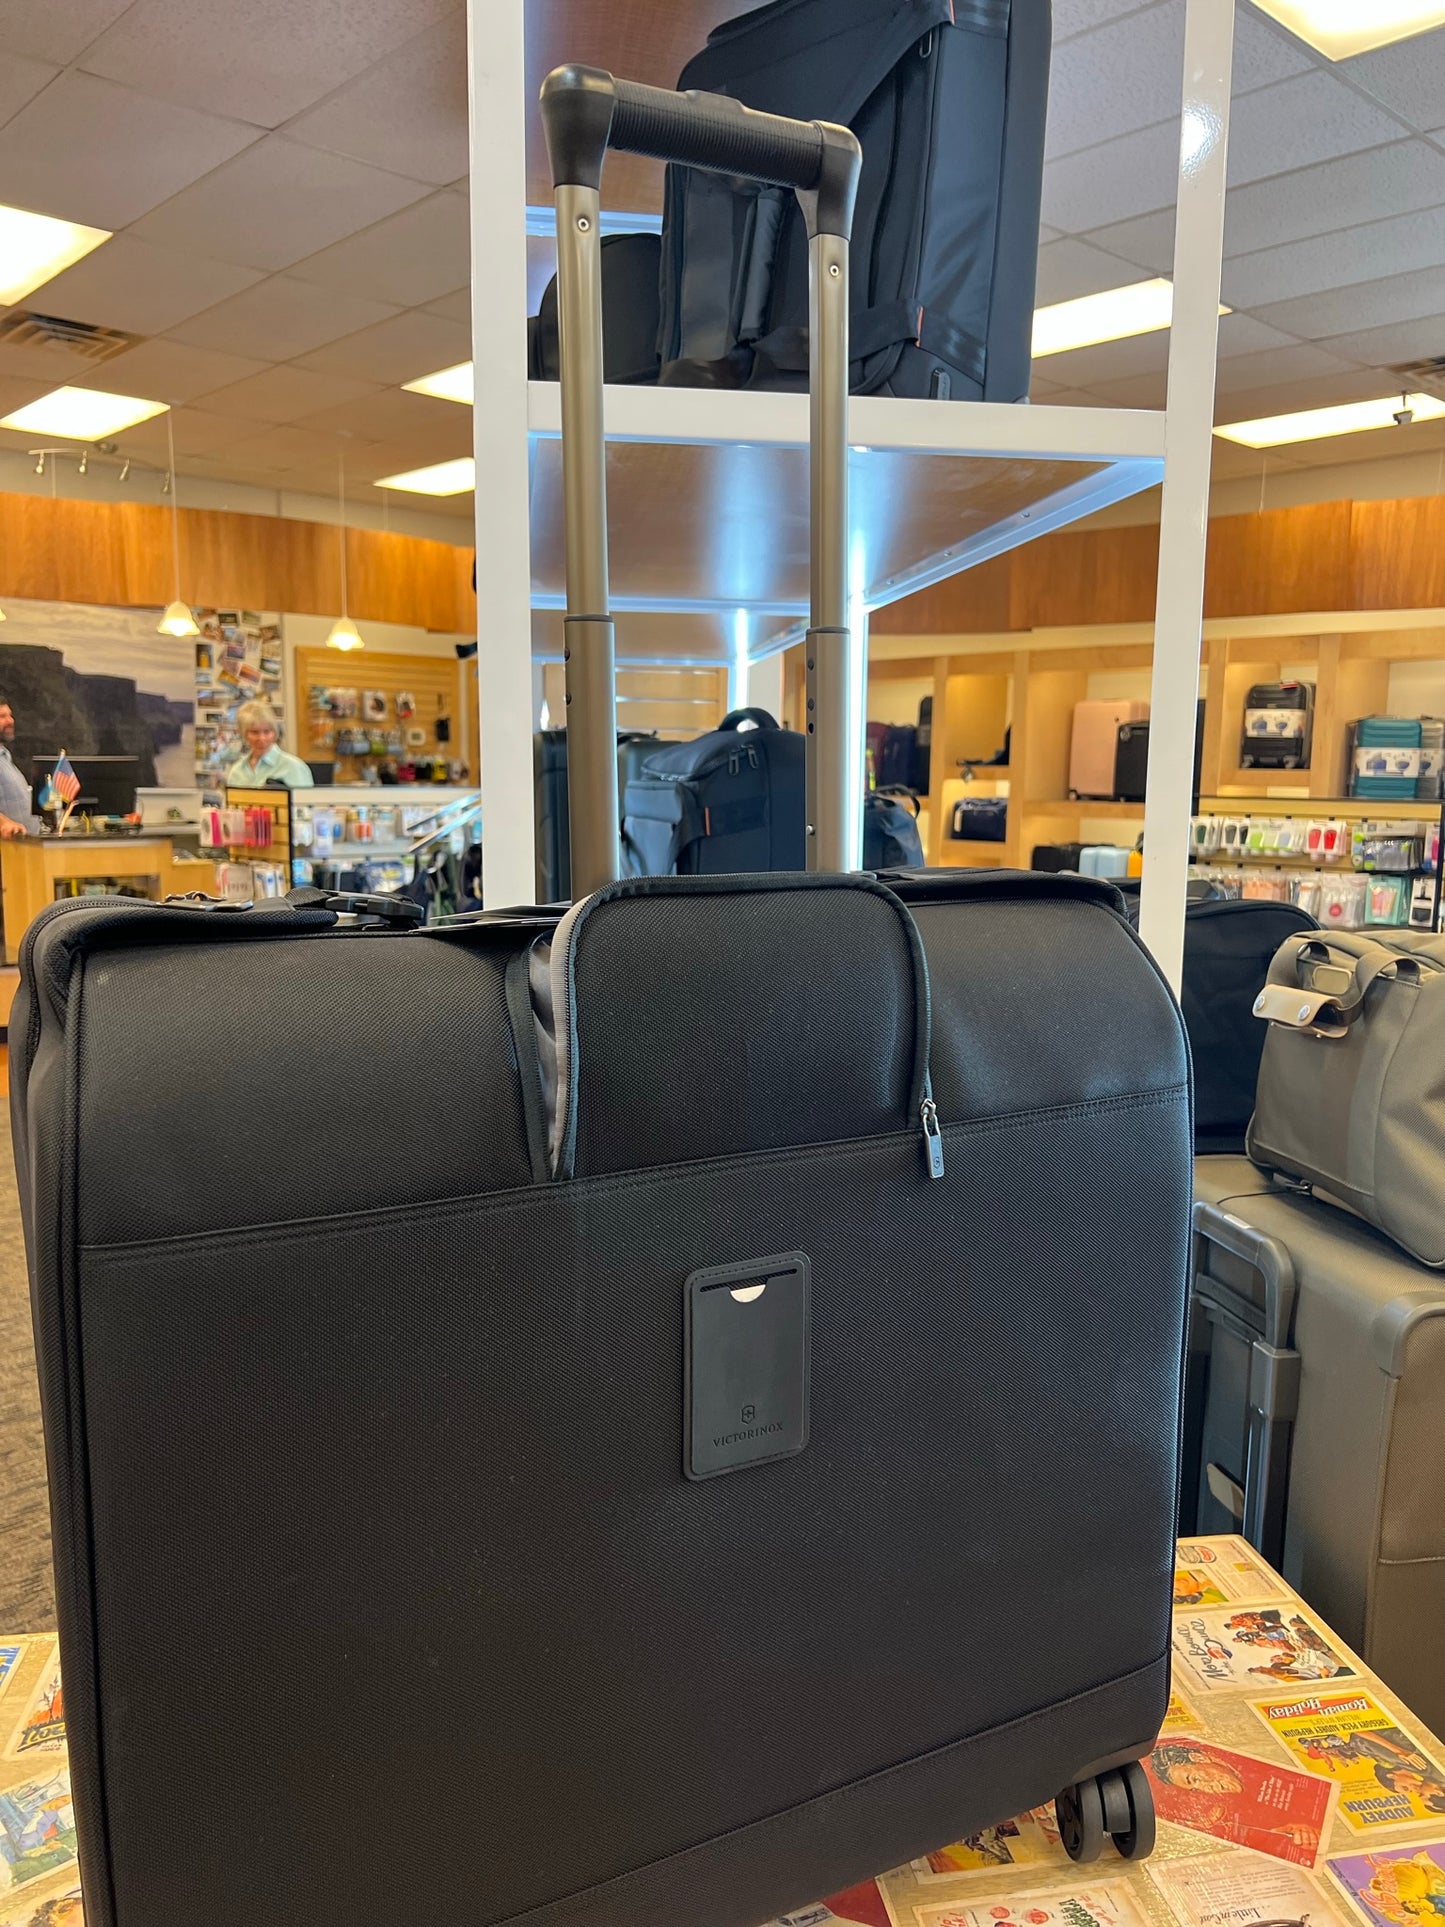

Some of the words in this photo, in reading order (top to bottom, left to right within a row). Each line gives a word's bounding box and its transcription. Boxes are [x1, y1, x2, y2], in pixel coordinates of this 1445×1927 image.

[712, 1422, 782, 1447] VICTORINOX
[1201, 1656, 1238, 1683] More
[1269, 1697, 1321, 1719] Holiday
[1318, 1697, 1369, 1717] Roman
[1282, 1726, 1314, 1737] HEPBURN
[1315, 1723, 1340, 1734] AUDREY
[1360, 1718, 1388, 1728] GREGORY
[1344, 1795, 1412, 1812] HEPBURN
[1360, 1805, 1415, 1824] AUDREY
[1221, 1911, 1231, 1922] in
